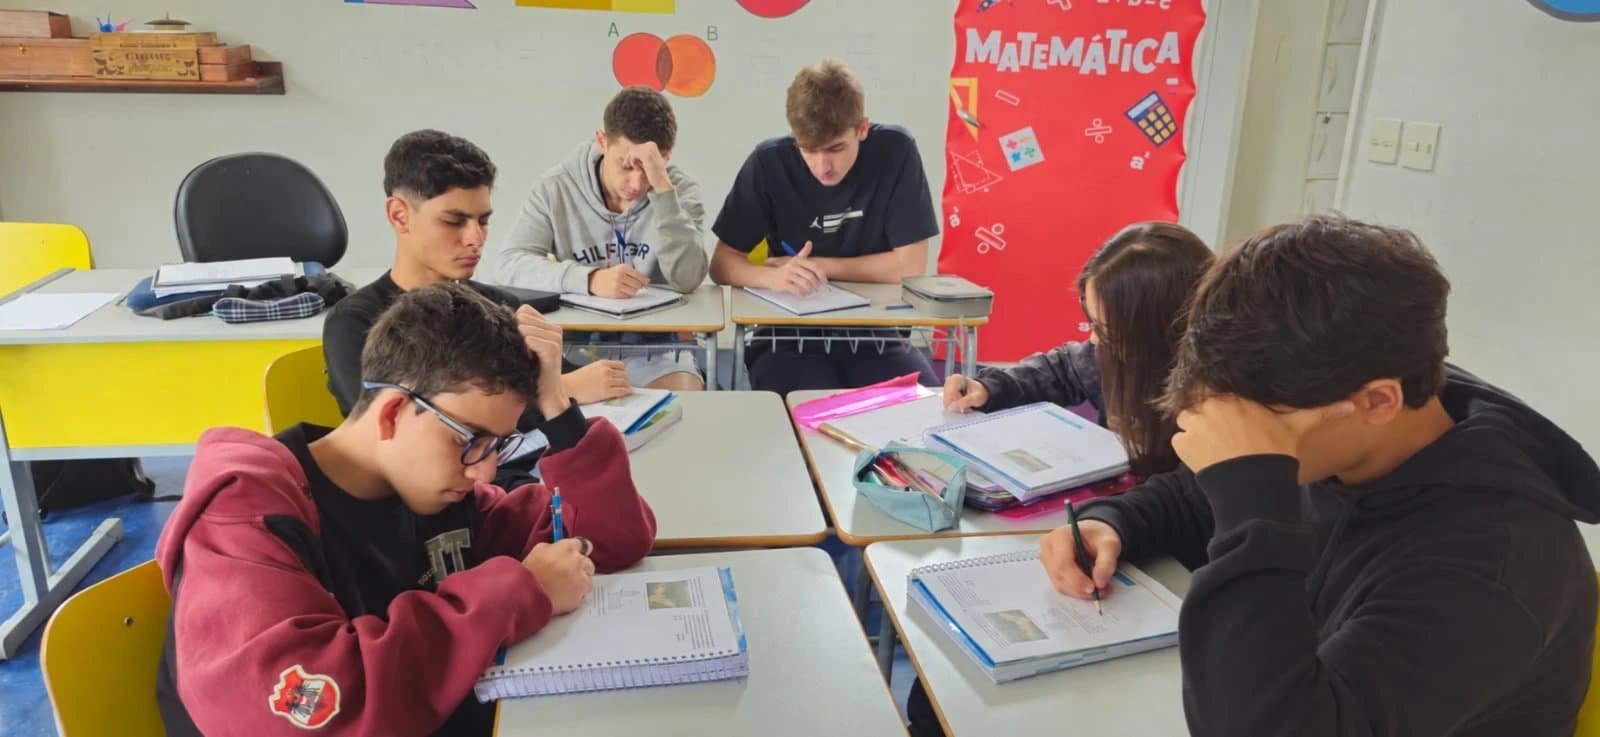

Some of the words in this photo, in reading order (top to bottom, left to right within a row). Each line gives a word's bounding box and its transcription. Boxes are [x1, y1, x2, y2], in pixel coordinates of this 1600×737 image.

[608, 22, 620, 38] A
[707, 25, 719, 41] B
[965, 28, 1180, 76] MATEMÁTICA
[573, 240, 650, 264] HILFIGR
